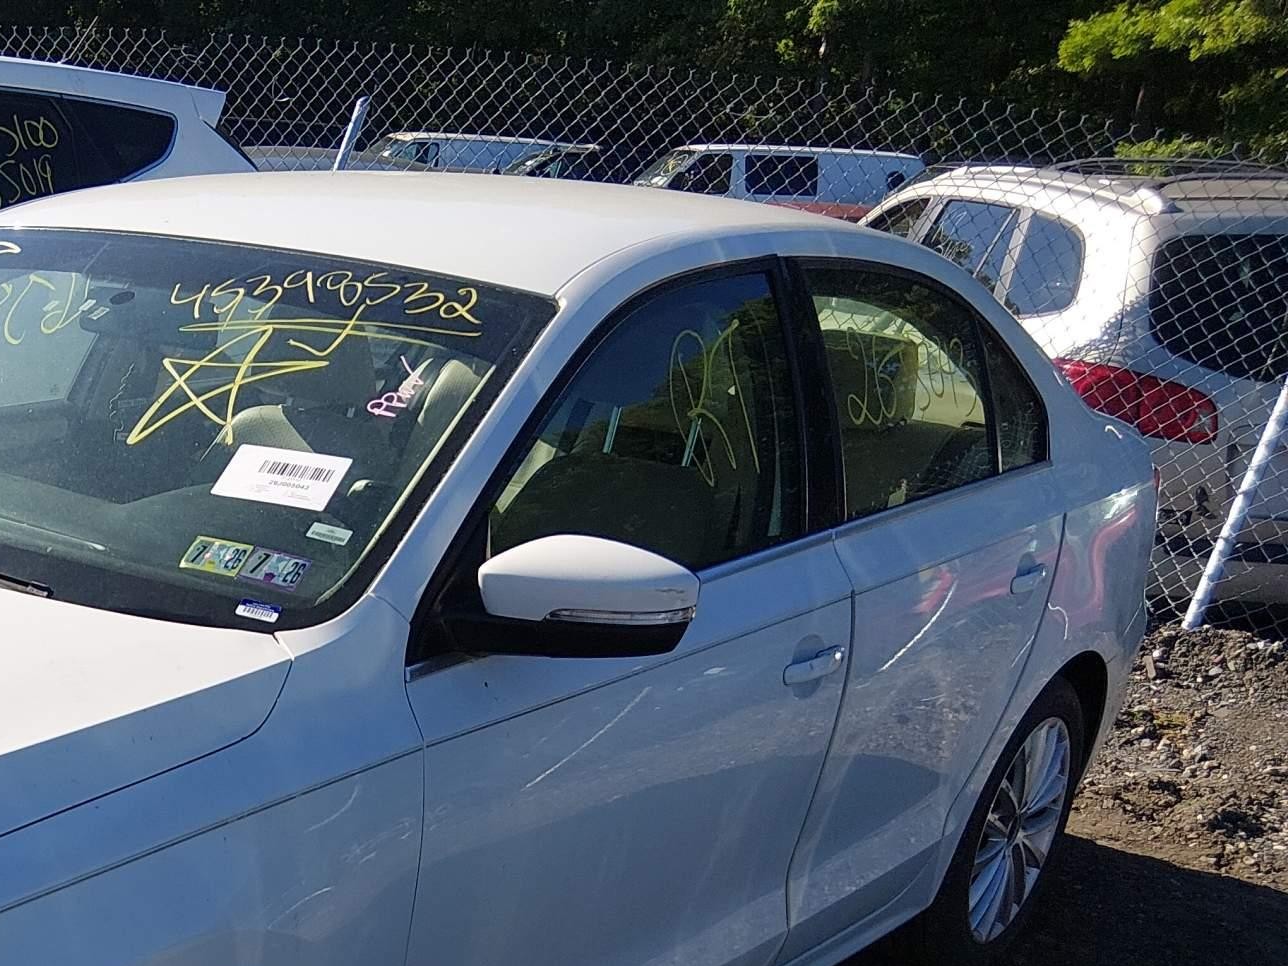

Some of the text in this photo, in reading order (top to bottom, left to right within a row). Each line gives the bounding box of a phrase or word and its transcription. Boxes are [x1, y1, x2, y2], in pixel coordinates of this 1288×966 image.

[171, 270, 482, 330] 45398532
[190, 544, 247, 570] 7 26
[249, 552, 307, 584] 7 26
